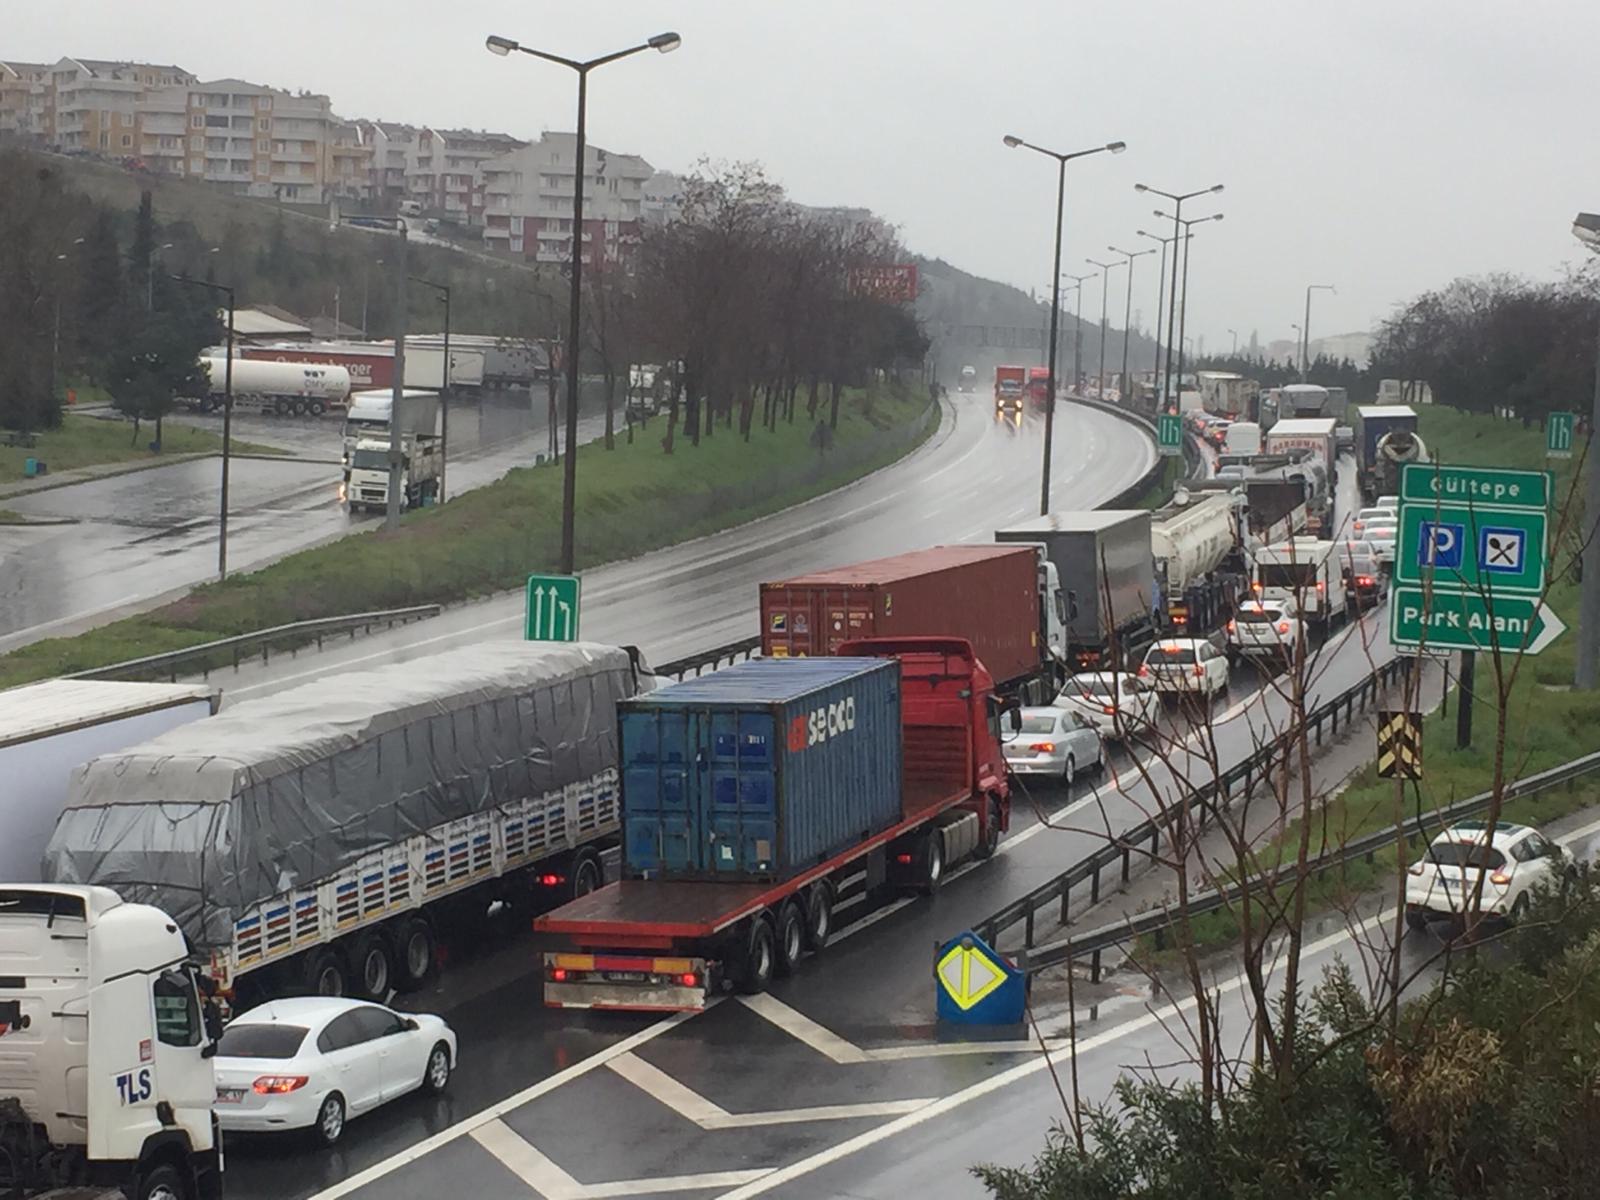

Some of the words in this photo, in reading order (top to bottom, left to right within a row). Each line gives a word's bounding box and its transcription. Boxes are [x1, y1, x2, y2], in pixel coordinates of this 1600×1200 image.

[1430, 477, 1520, 499] Gültepe
[1427, 526, 1455, 565] P
[1403, 606, 1460, 628] Park
[1468, 611, 1529, 634] Alanı
[116, 1068, 152, 1107] TLS
